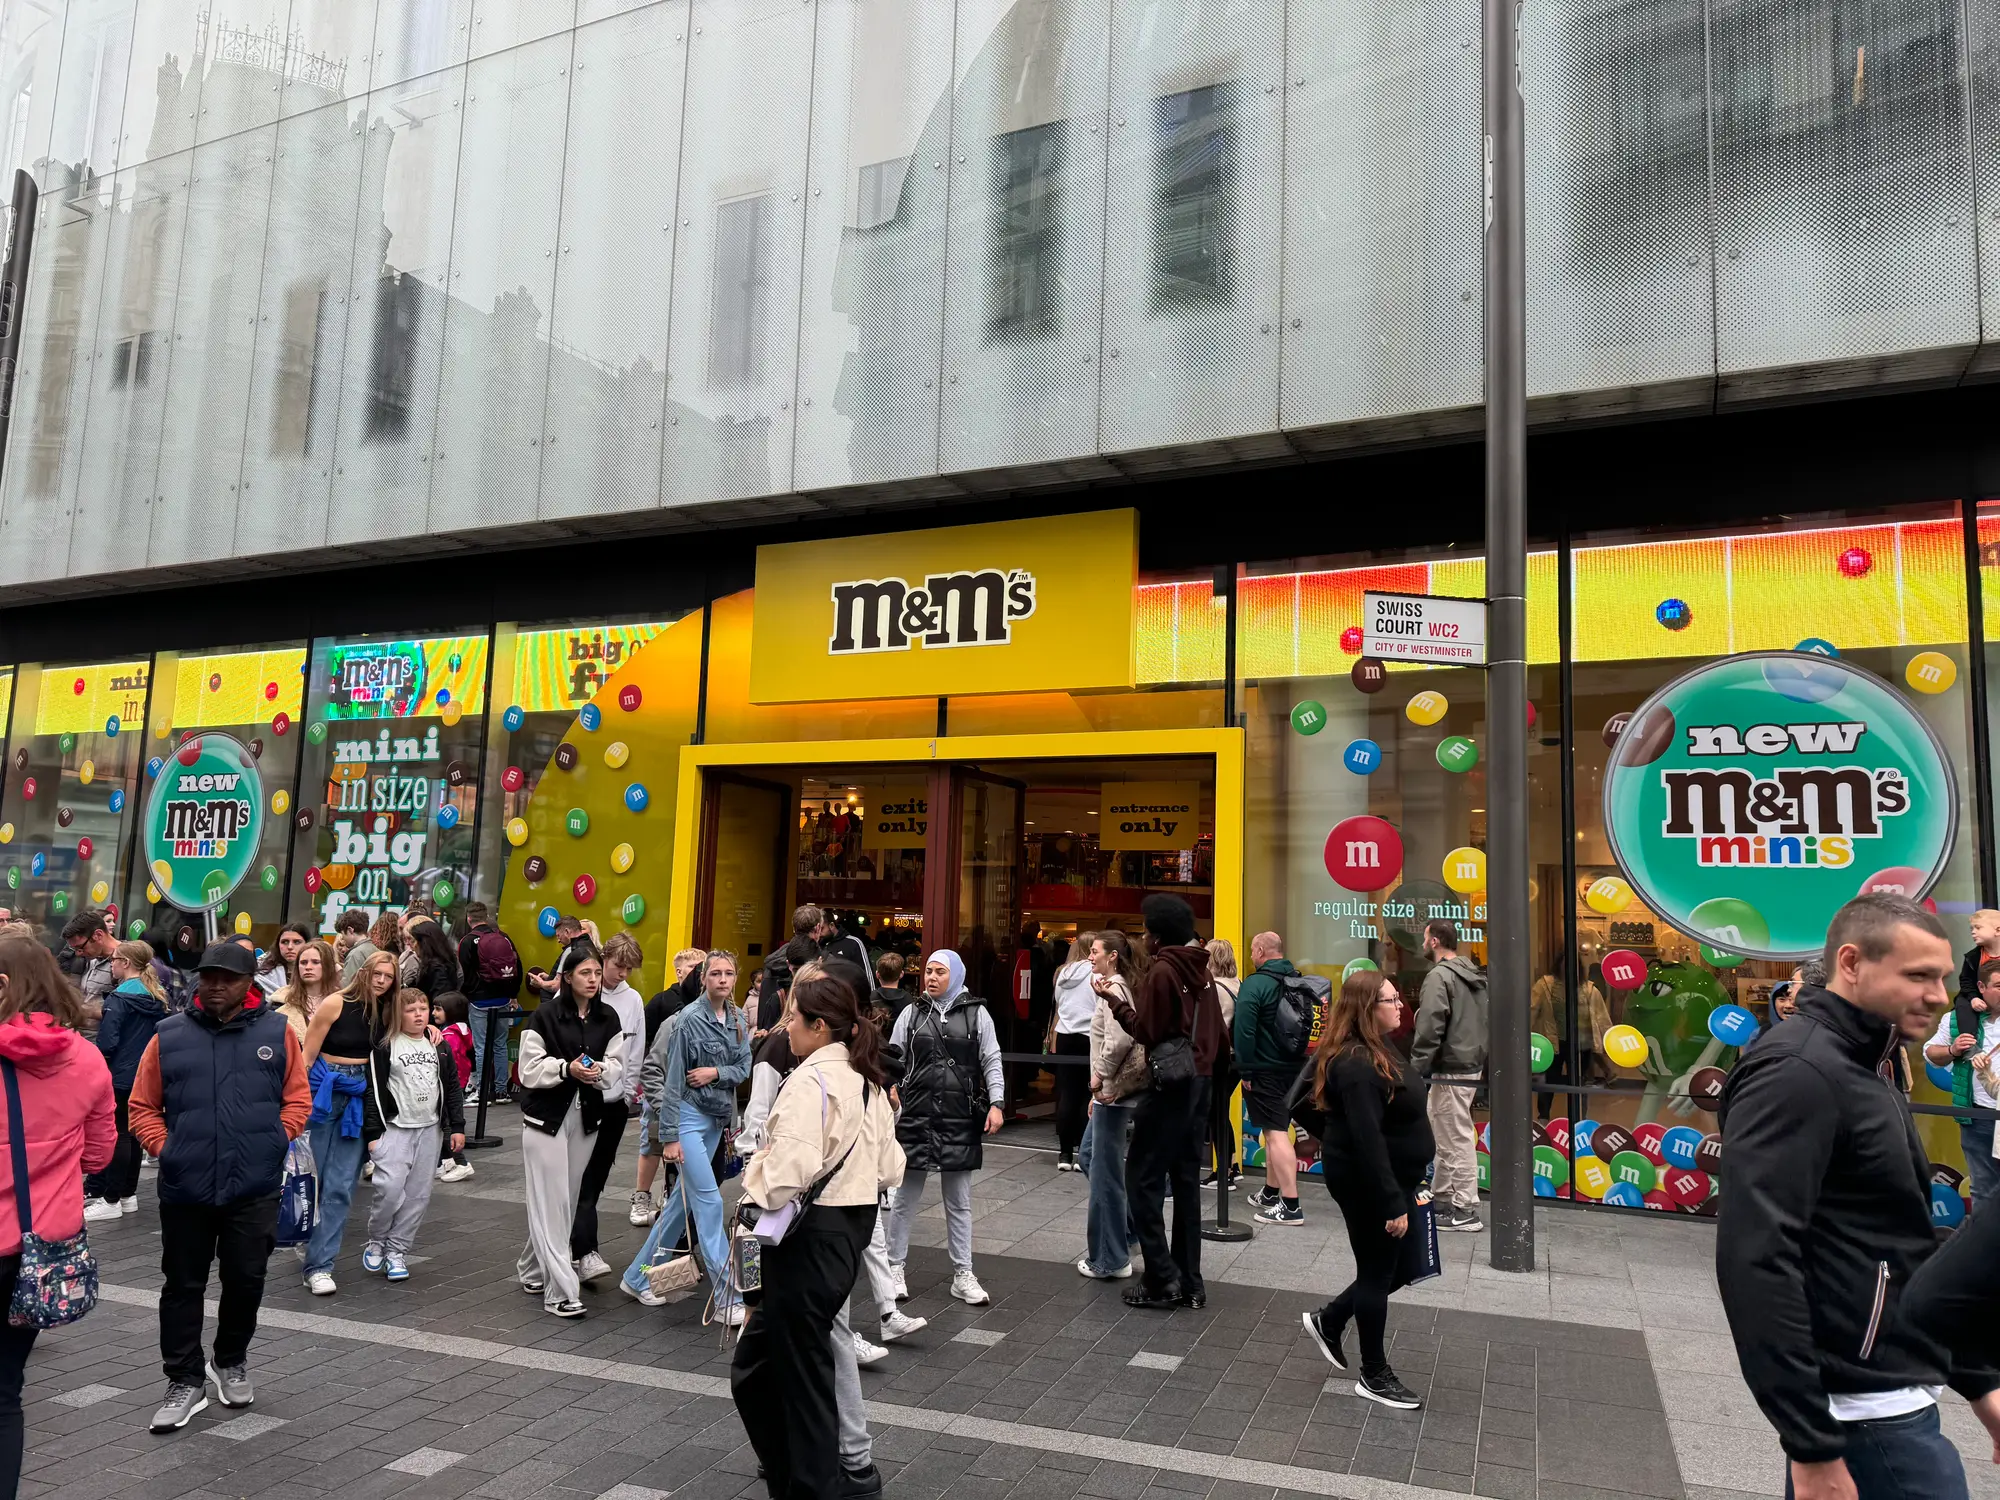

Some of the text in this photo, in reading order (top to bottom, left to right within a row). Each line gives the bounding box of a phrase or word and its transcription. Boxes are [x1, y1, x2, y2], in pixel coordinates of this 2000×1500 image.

[1377, 600, 1422, 617] SWISS
[1376, 618, 1423, 636] COURT
[1428, 622, 1458, 638] WC2
[568, 634, 624, 664] big
[1375, 642, 1472, 658] CITY OF WESTMINSTER
[1364, 666, 1380, 679] m
[1917, 664, 1942, 683] m
[623, 694, 635, 706] m
[1415, 696, 1436, 712] m
[508, 712, 519, 724] m
[583, 713, 592, 726] m
[1299, 710, 1318, 726] m
[336, 727, 440, 762] mini
[1688, 723, 1865, 755] new
[559, 751, 570, 764] m
[610, 746, 622, 757] m
[928, 740, 936, 758] 1
[1353, 749, 1370, 765] m
[1448, 742, 1469, 760] m
[178, 774, 240, 792] new
[507, 770, 518, 782] m
[338, 766, 428, 812] in size
[632, 789, 644, 801] m
[881, 798, 927, 814] exit
[1110, 804, 1190, 814] entrance
[513, 824, 523, 836] m
[570, 818, 580, 829] m
[878, 818, 927, 836] only
[1120, 818, 1178, 836] only
[174, 840, 227, 856] minis
[332, 816, 426, 876] big
[1345, 841, 1380, 867] m
[1700, 836, 1850, 865] minis
[529, 860, 540, 872] m
[619, 853, 630, 867] m
[1456, 863, 1477, 879] m
[357, 868, 388, 900] on
[577, 881, 588, 896] m
[1596, 882, 1618, 899] m
[626, 901, 636, 914] m
[1314, 898, 1378, 920] regular
[1382, 901, 1415, 918] size
[1428, 901, 1469, 920] mini
[1350, 920, 1378, 939] fun
[1612, 964, 1635, 981] m
[1310, 1004, 1321, 1036] FACE
[1721, 1011, 1745, 1031] m
[1619, 1035, 1640, 1052] m
[1603, 1131, 1627, 1151] m
[1674, 1138, 1693, 1158] m
[1534, 1159, 1553, 1179] m
[1585, 1166, 1604, 1187] m
[1619, 1164, 1640, 1184] m
[1674, 1174, 1699, 1195] m
